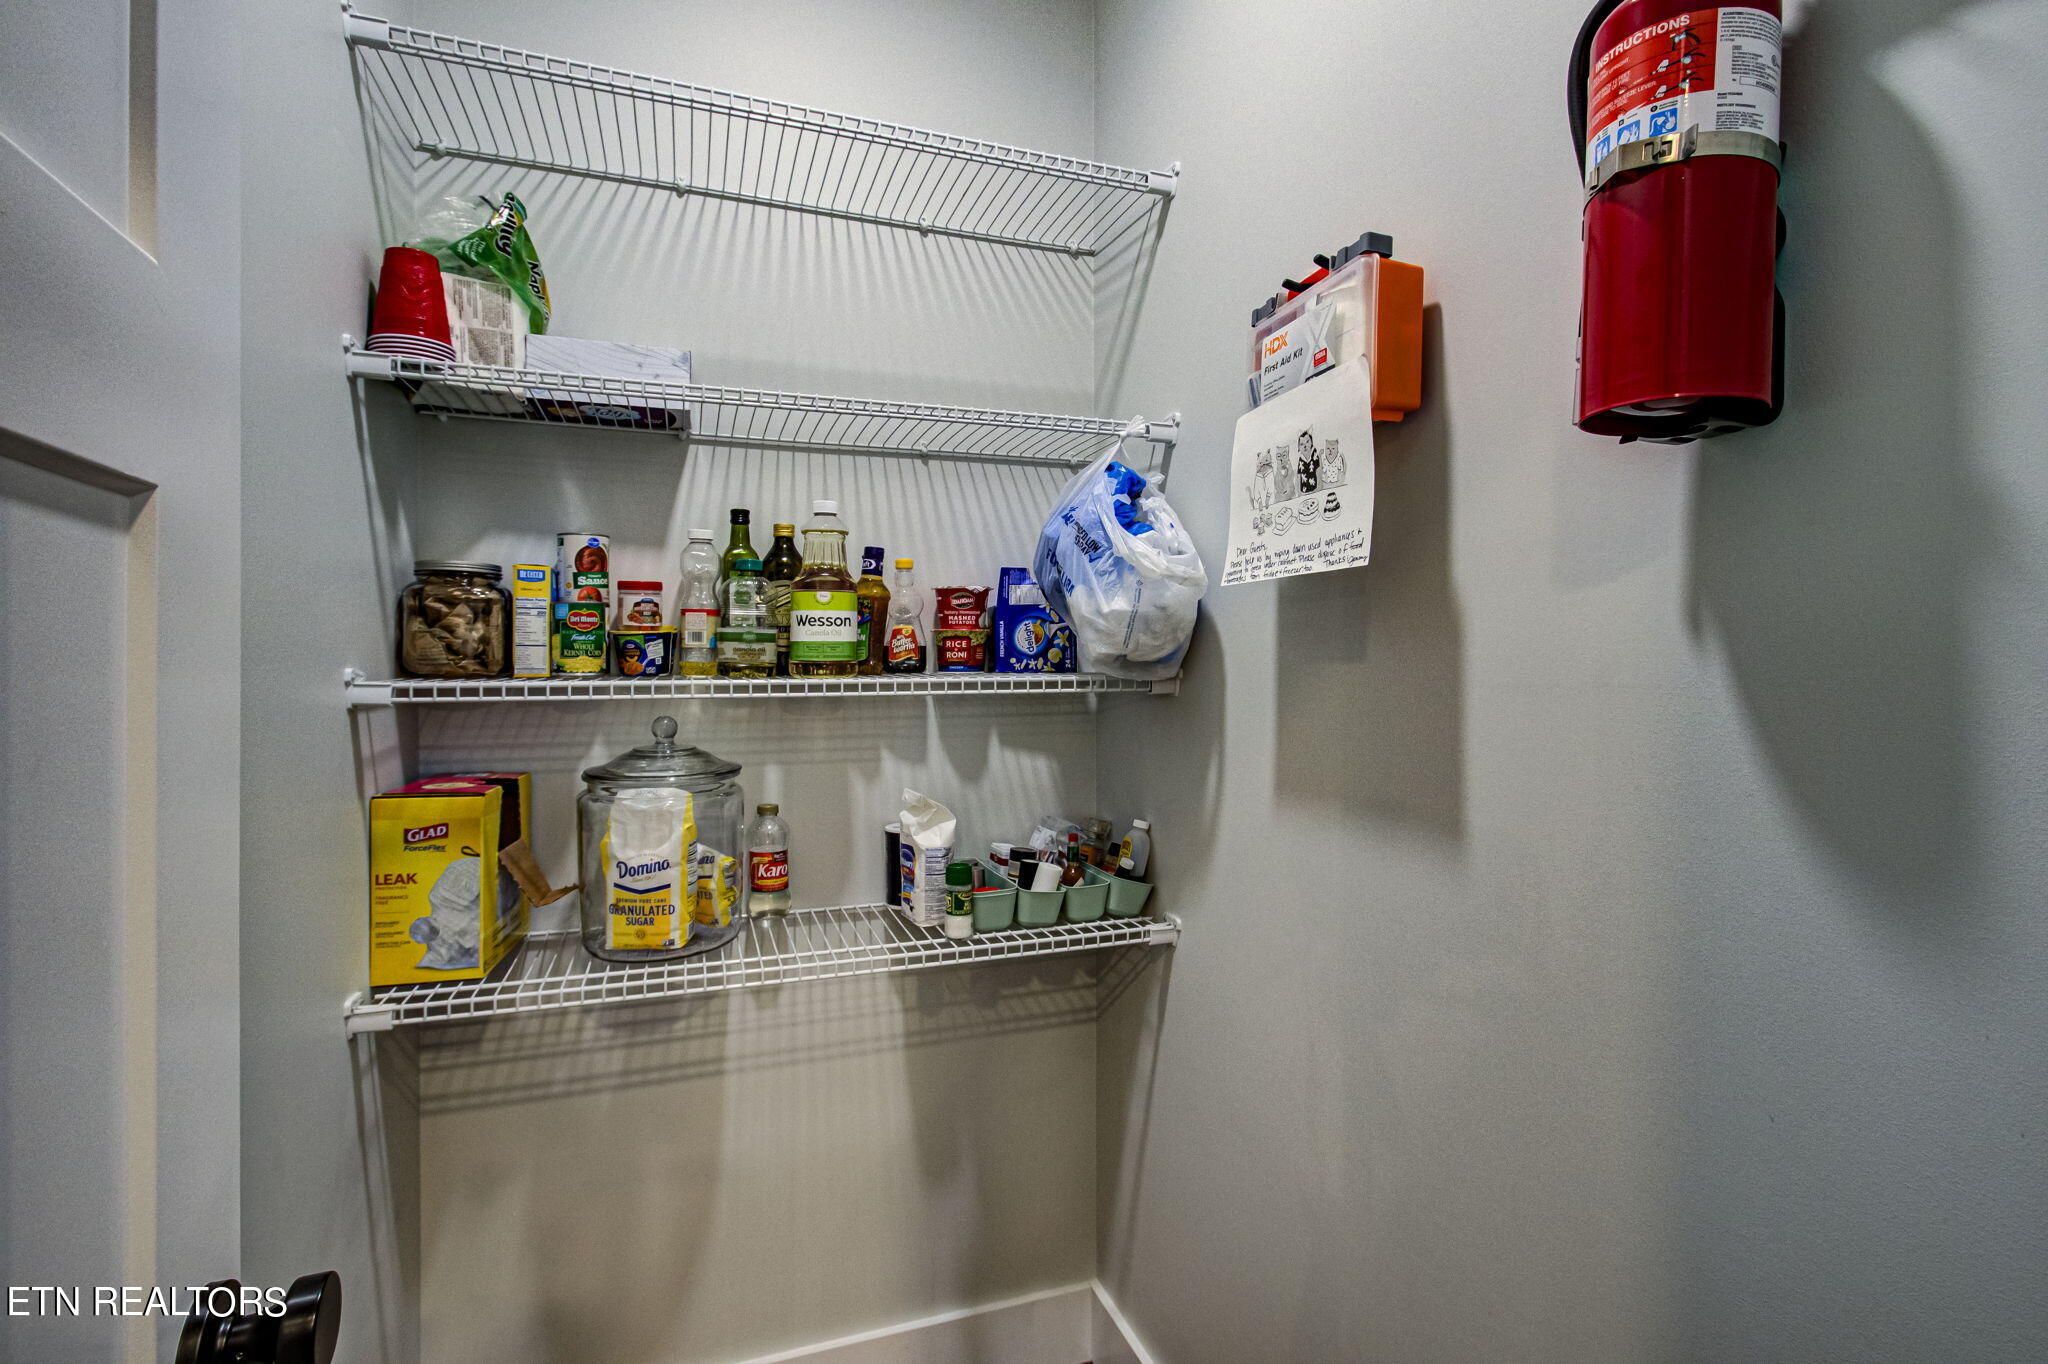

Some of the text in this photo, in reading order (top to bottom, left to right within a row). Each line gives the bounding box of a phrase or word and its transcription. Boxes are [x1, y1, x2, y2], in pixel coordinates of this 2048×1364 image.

[1595, 14, 1690, 73] INSTRUCTIONS
[1264, 331, 1288, 358] HDX
[1264, 361, 1279, 375] First
[1280, 354, 1292, 367] Aid
[1293, 347, 1303, 360] Kit
[1086, 538, 1102, 553] LOW
[1308, 537, 1322, 551] used
[796, 614, 852, 627] Wesson
[1023, 620, 1035, 653] delight
[945, 640, 967, 648] RICE
[946, 651, 967, 659] RONI
[407, 826, 447, 842] GLAD
[616, 859, 670, 879] Domino
[758, 864, 788, 878] Karo
[375, 873, 418, 886] LEAK
[609, 903, 675, 916] GRANULATED
[625, 917, 655, 926] SUGAR
